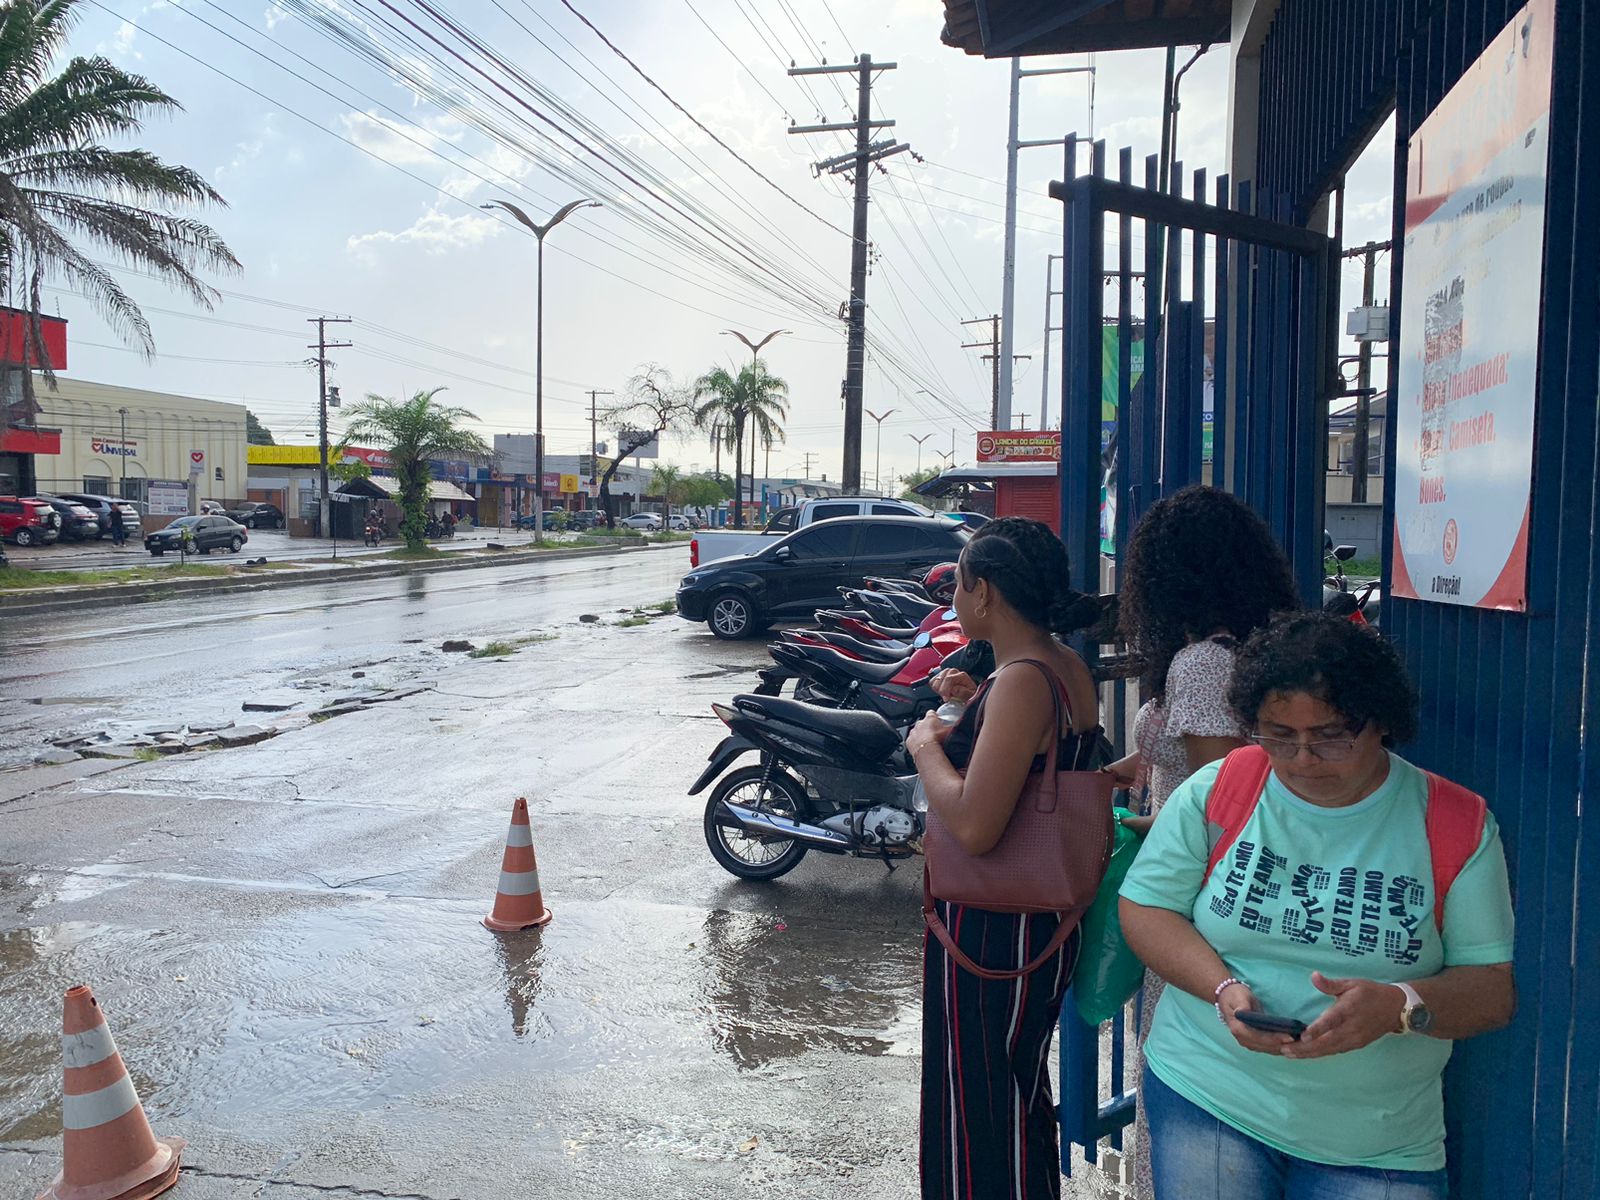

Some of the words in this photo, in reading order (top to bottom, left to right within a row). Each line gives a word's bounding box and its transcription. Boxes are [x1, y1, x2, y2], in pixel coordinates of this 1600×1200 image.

[1436, 575, 1461, 598] Direção!
[1235, 840, 1255, 871] AMO
[1253, 845, 1276, 886] AMO
[1225, 870, 1246, 887] TE
[1291, 864, 1313, 898] AMO
[1336, 866, 1358, 899] AMO
[1363, 870, 1384, 904] AMO
[1245, 883, 1267, 905] TE
[1387, 876, 1409, 917] AMO
[1239, 906, 1260, 931] EU
[1300, 896, 1325, 918] TE
[1333, 898, 1354, 916] TE
[1361, 903, 1381, 920] TE
[1300, 918, 1325, 944] EU
[1330, 917, 1351, 938] EU
[1358, 922, 1379, 944] EU
[1399, 914, 1419, 938] TE
[1402, 939, 1423, 963] EU
